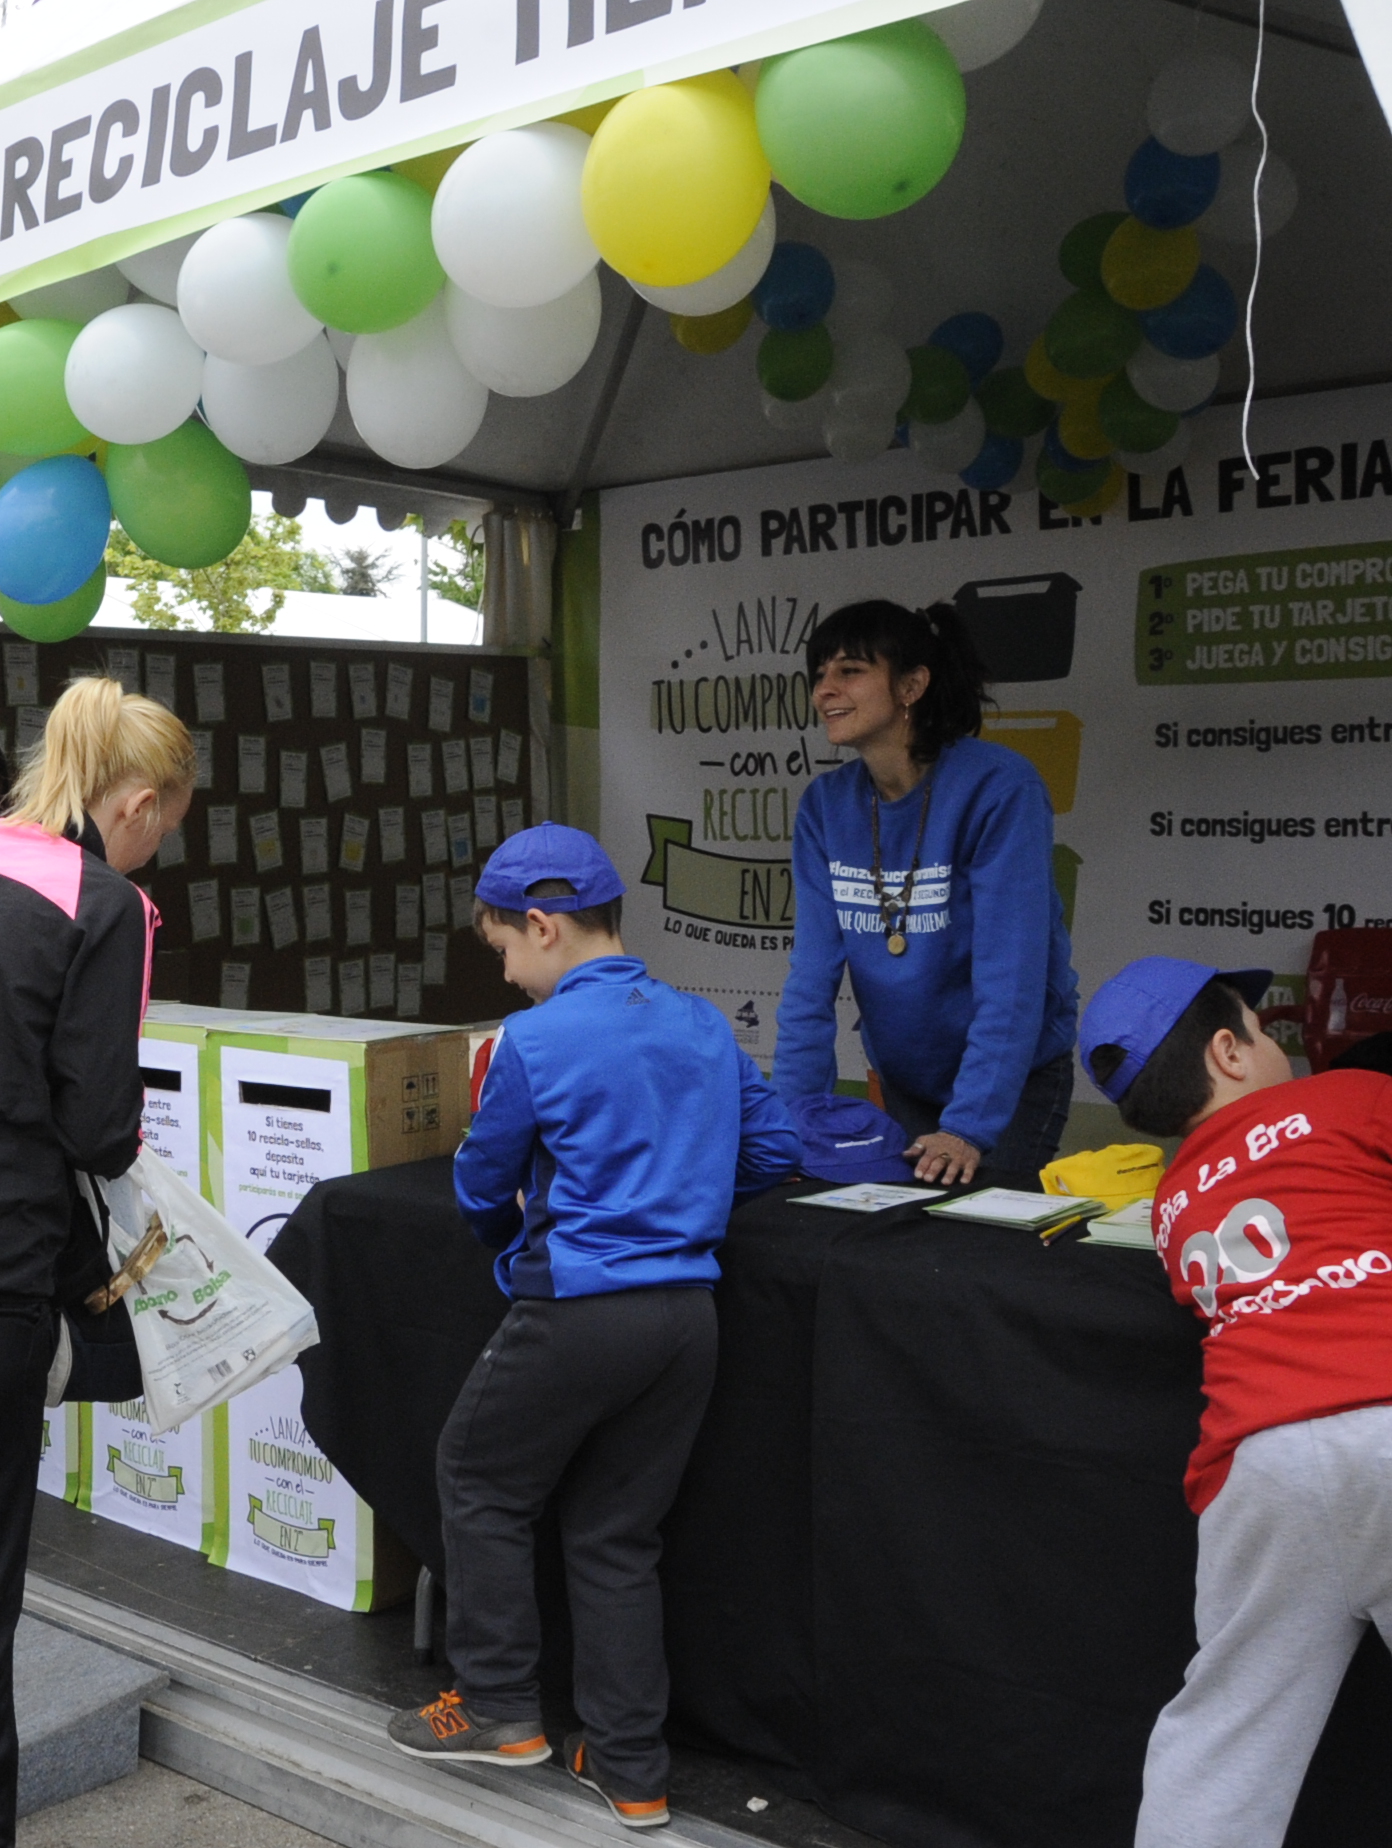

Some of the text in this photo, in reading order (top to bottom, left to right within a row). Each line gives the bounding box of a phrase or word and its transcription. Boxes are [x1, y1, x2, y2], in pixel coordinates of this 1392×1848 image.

[0, 0, 457, 242] RECICLAJE
[641, 508, 742, 569] CÓMO
[760, 488, 1012, 557] PARTICIPAR
[1128, 465, 1193, 522] LA
[1218, 438, 1392, 513] FERIA
[1186, 569, 1250, 597] PEGA
[1256, 566, 1288, 592] TU
[1186, 607, 1242, 633] PIDE
[1249, 604, 1281, 629] TU
[1186, 642, 1265, 670] JUEGA
[1270, 640, 1288, 666] Y
[652, 678, 685, 734] TU
[1155, 721, 1178, 748] Si
[1186, 719, 1322, 753] consigues
[1150, 811, 1173, 838] Si
[1180, 810, 1316, 844] consigues
[739, 868, 770, 922] EN
[664, 917, 682, 934] LO
[685, 922, 711, 942] QUE
[715, 929, 756, 950] QUEDA
[761, 936, 778, 950] ES
[1148, 900, 1172, 925] Si
[1178, 901, 1315, 935] consigues
[1322, 903, 1356, 929] 10
[148, 1099, 171, 1110] entre
[247, 1130, 257, 1141] 10
[265, 1115, 303, 1131] Si tienes
[265, 1150, 304, 1165] deposita
[1197, 1156, 1237, 1192] La
[1245, 1112, 1312, 1162] Era
[249, 1165, 267, 1179] aquí
[270, 1167, 280, 1179] tu
[192, 1269, 232, 1306] Bolsa
[249, 1438, 333, 1484] TU COMPROMISO
[266, 1489, 314, 1525] RECICLAJE
